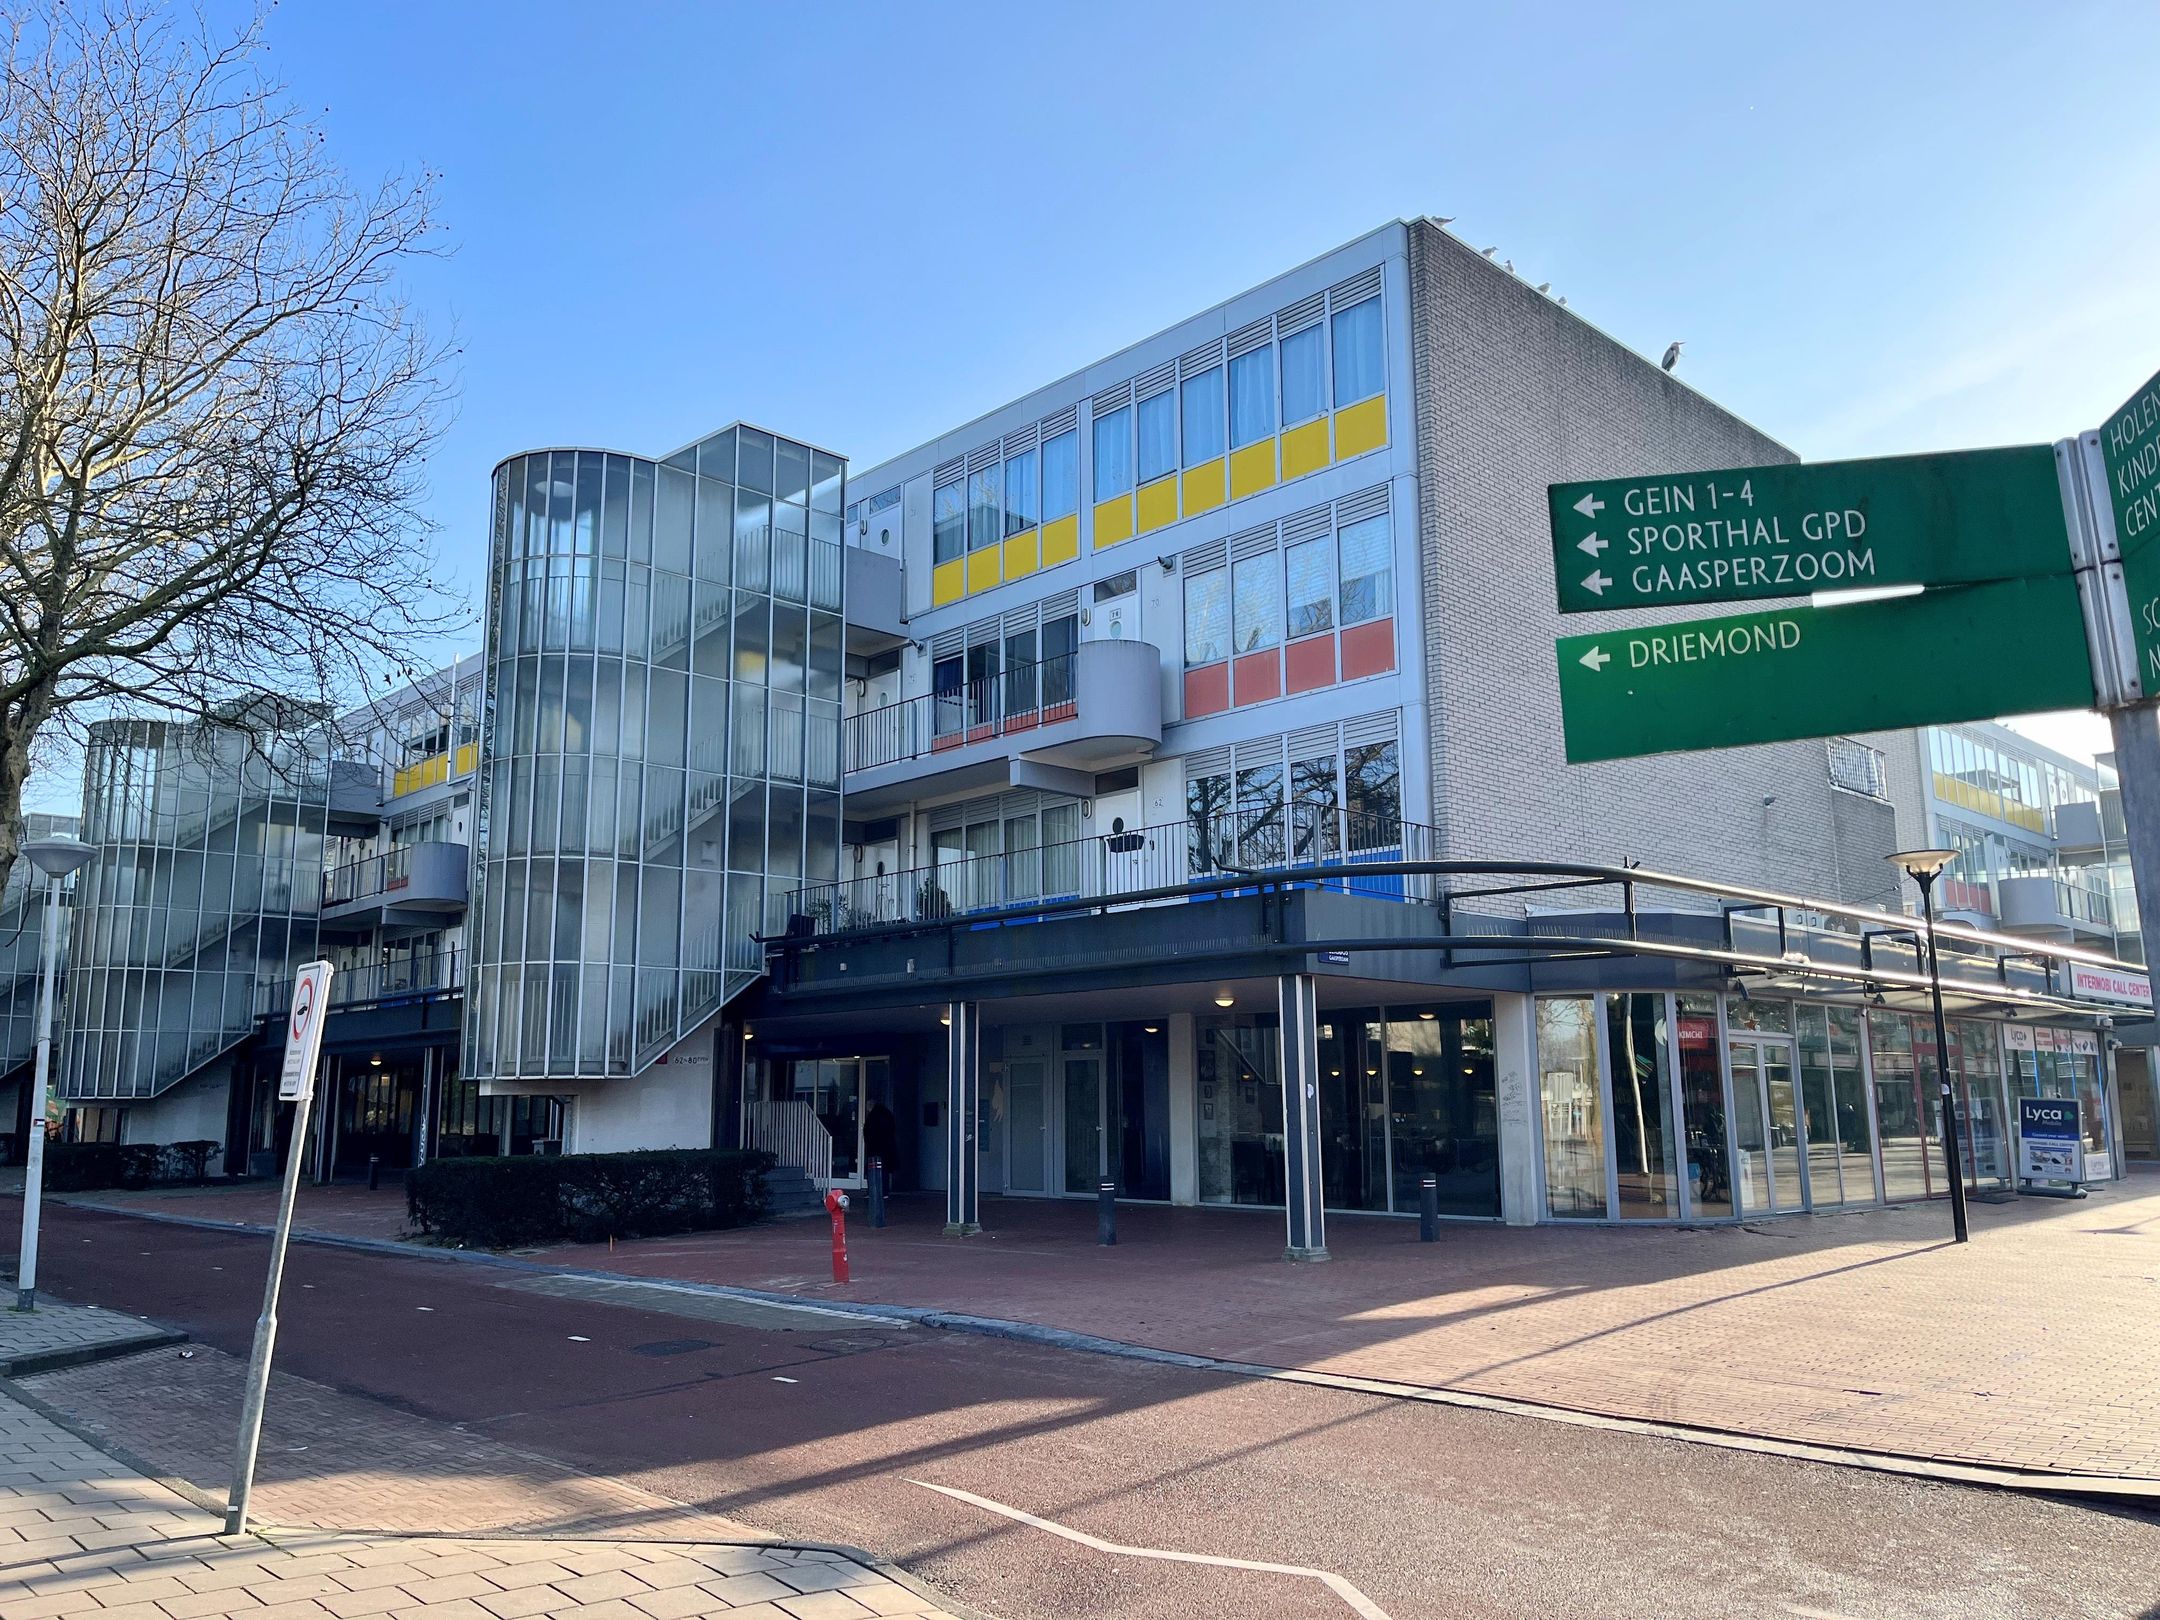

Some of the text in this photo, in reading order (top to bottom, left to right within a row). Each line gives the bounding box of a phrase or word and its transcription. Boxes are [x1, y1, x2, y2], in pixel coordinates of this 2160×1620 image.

[1624, 479, 1754, 516] GEIN 1-4
[1627, 509, 1867, 555] SPORTHAL GPD
[1632, 547, 1876, 593] GAASPERZOOM
[1629, 621, 1801, 668] DRIEMOND
[2077, 973, 2151, 998] INTERMOBI CALL CENTER
[1679, 1030, 1704, 1039] KIMCHI
[2025, 1106, 2062, 1121] Lyca
